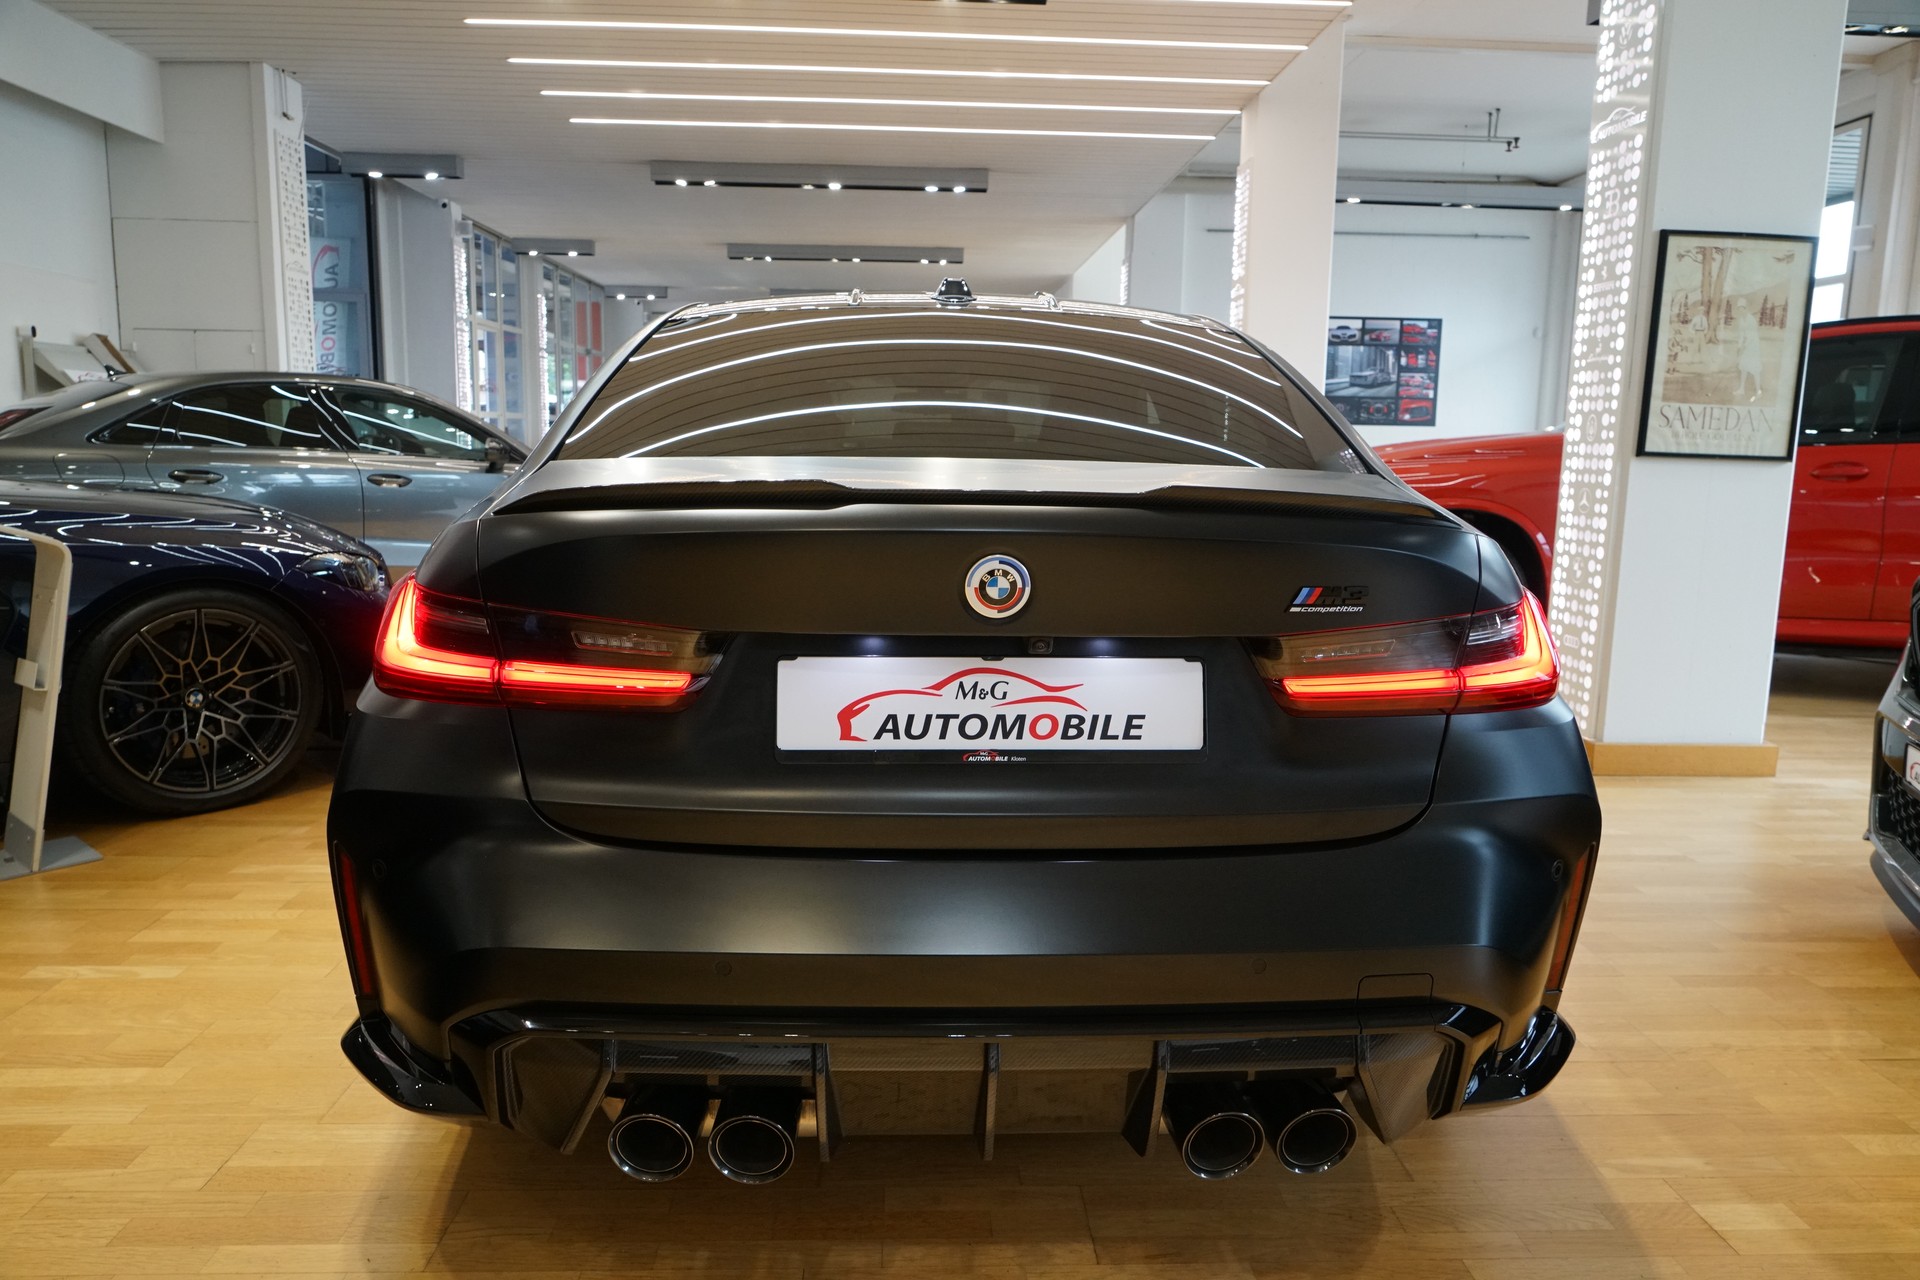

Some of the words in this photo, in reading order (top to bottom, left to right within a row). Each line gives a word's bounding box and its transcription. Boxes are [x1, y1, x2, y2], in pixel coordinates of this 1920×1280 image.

[1658, 404, 1776, 433] SAMEDAN
[982, 569, 1016, 583] BMW
[955, 680, 1009, 701] M&G
[873, 712, 1147, 741] AUTOMOBILE
